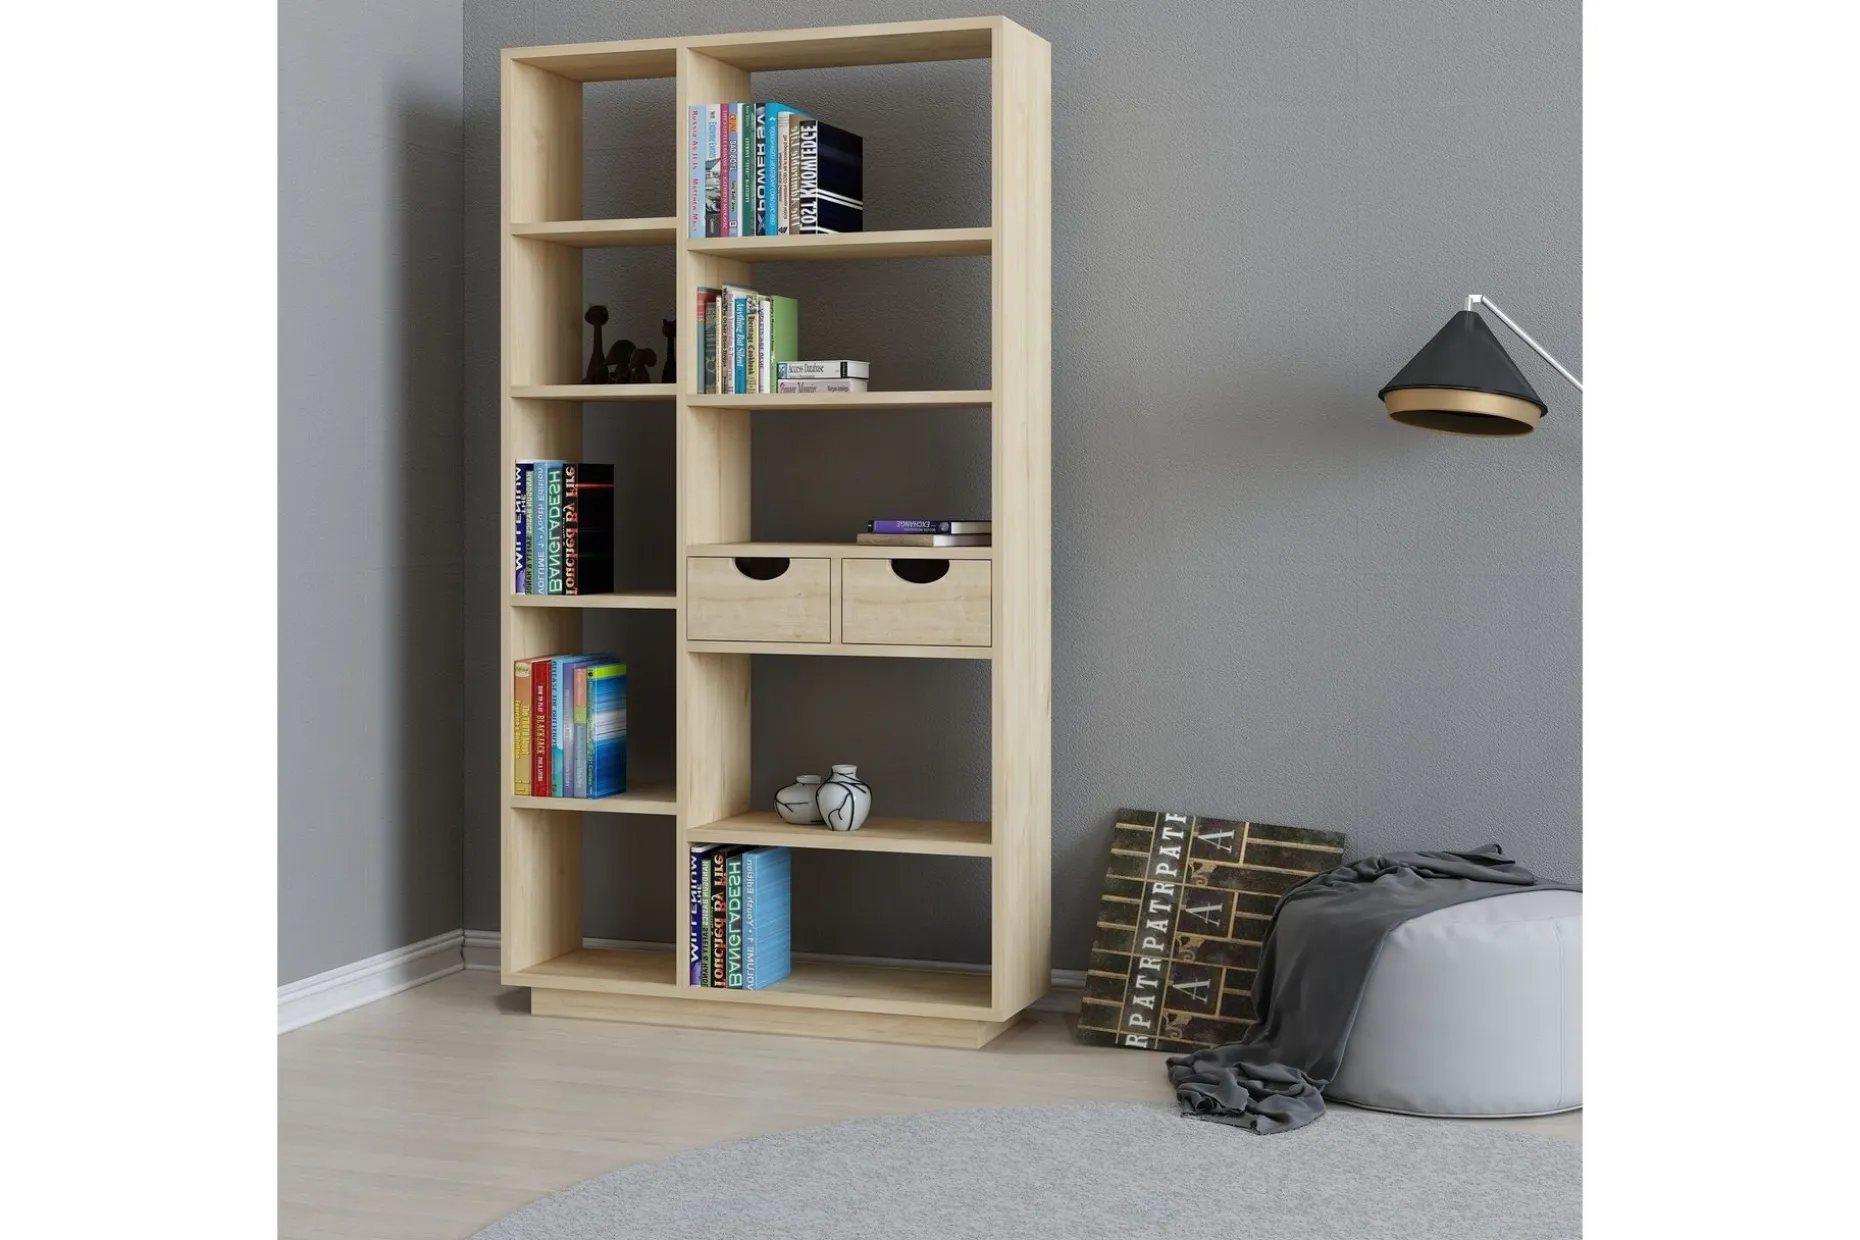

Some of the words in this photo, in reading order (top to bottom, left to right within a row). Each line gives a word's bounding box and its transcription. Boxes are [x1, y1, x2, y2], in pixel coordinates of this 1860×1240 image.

[729, 140, 738, 153] BAD
[735, 301, 745, 333] Anything
[735, 333, 745, 346] But
[735, 347, 745, 368] Silent
[747, 344, 756, 375] Cookbook
[536, 715, 546, 755] BLACKJACK
